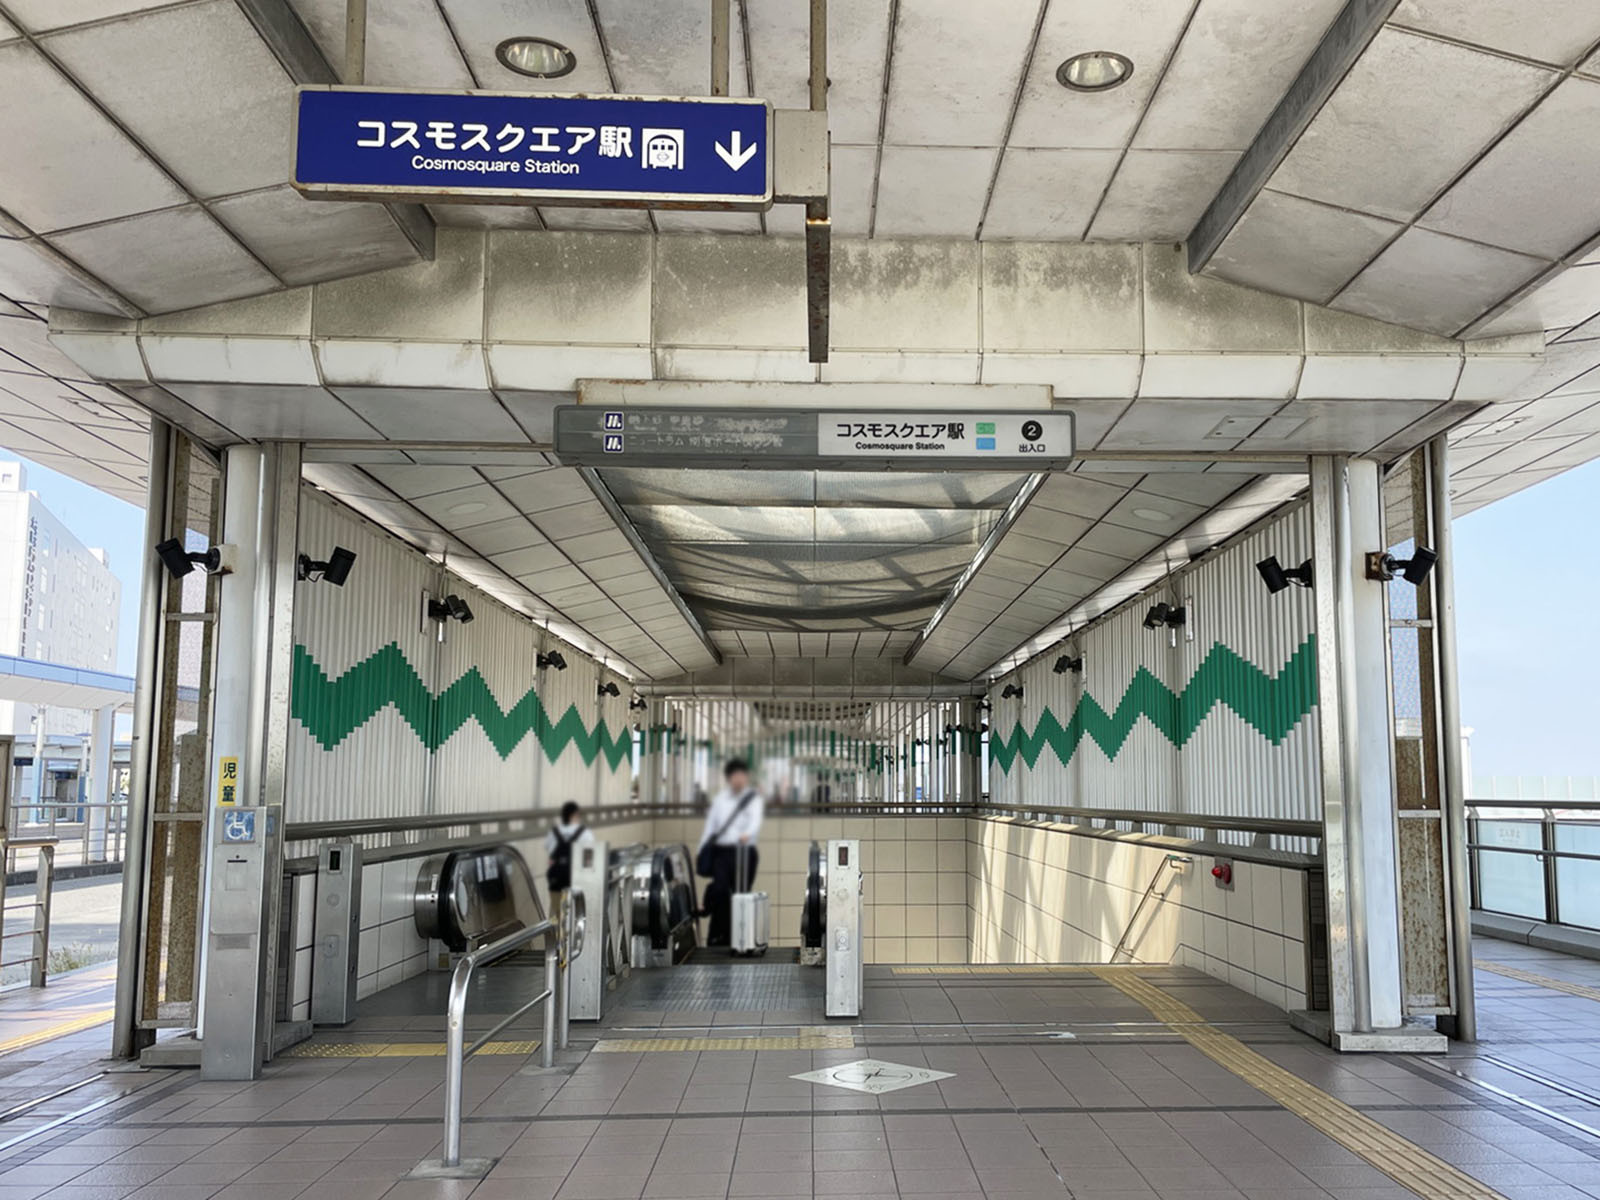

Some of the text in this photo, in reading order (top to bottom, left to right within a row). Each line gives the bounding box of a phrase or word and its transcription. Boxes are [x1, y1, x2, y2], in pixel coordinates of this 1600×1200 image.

[357, 121, 633, 158] コスモスクエア駅
[411, 155, 580, 174] Cosmosquare Station
[837, 422, 965, 440] コスモスクエア駅
[855, 441, 945, 451] Cosmosquare Station
[1018, 443, 1046, 453] 出入口
[222, 762, 236, 802] 児童
